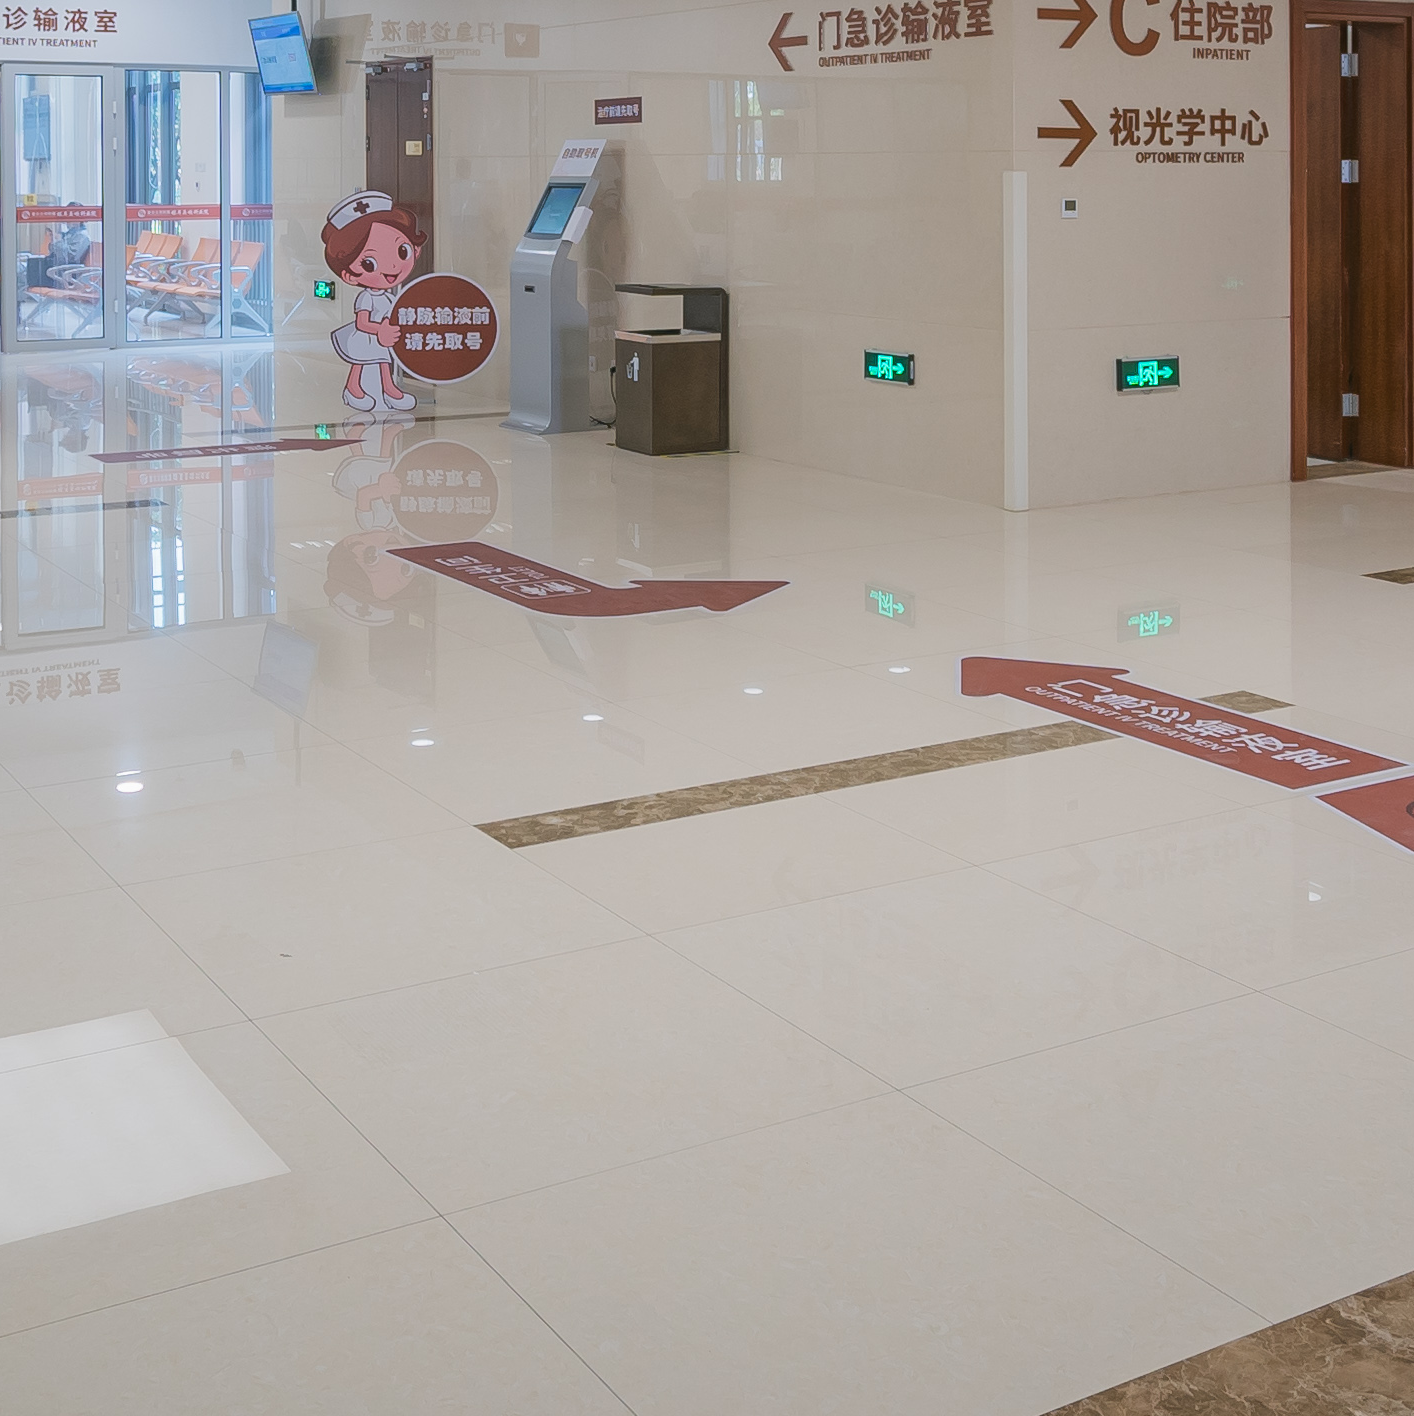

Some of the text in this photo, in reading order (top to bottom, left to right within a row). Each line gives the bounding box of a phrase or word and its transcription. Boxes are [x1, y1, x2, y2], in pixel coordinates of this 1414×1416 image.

[1170, 0, 1274, 46] 住院部
[28, 38, 38, 47] IV
[40, 38, 98, 48] TREATMENT
[818, 48, 932, 68] OUTPATIENT IV TREATMENT
[1192, 47, 1251, 61] INPATIENT
[1109, 107, 1270, 148] 视光学中心
[562, 147, 599, 159] 自助取号机
[1135, 151, 1245, 165] OPTOMETRY CENTER
[398, 306, 490, 325] 静脉输液前
[405, 332, 483, 351] 请先取号
[435, 555, 529, 584] 卫生间
[1024, 685, 1112, 716] OUTPATIENT
[1141, 722, 1238, 755] TREATMENT
[1049, 679, 1352, 771] 门急诊输液室
